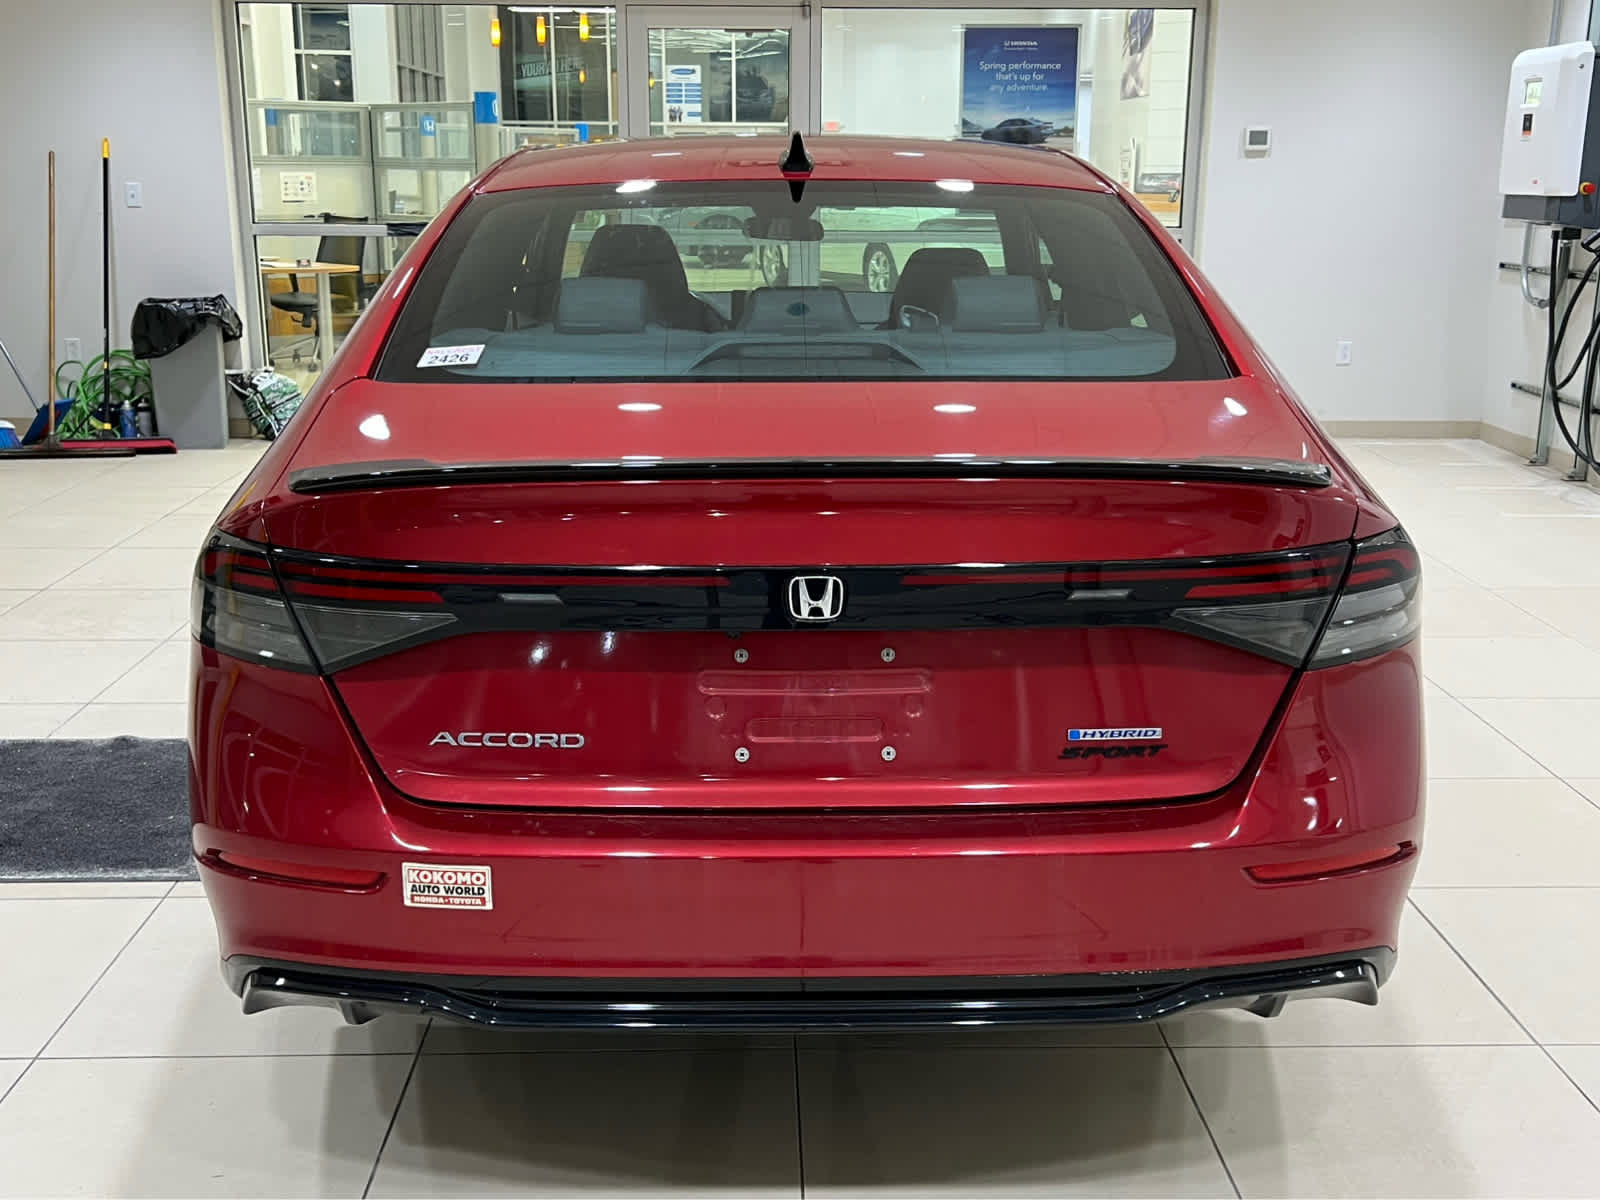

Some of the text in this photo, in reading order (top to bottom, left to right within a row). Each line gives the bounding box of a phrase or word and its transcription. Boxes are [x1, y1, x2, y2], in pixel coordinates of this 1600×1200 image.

[979, 61, 1062, 72] Spring performance
[995, 72, 1044, 82] that's up for
[427, 354, 470, 364] 2426
[428, 732, 585, 748] ACCORD
[1082, 730, 1157, 739] HYBRID
[1058, 744, 1168, 760] SPORT
[408, 869, 485, 885] KOKOMO
[411, 884, 485, 896] AUTO WORLD
[413, 896, 482, 905] HONDA TOYOTA
